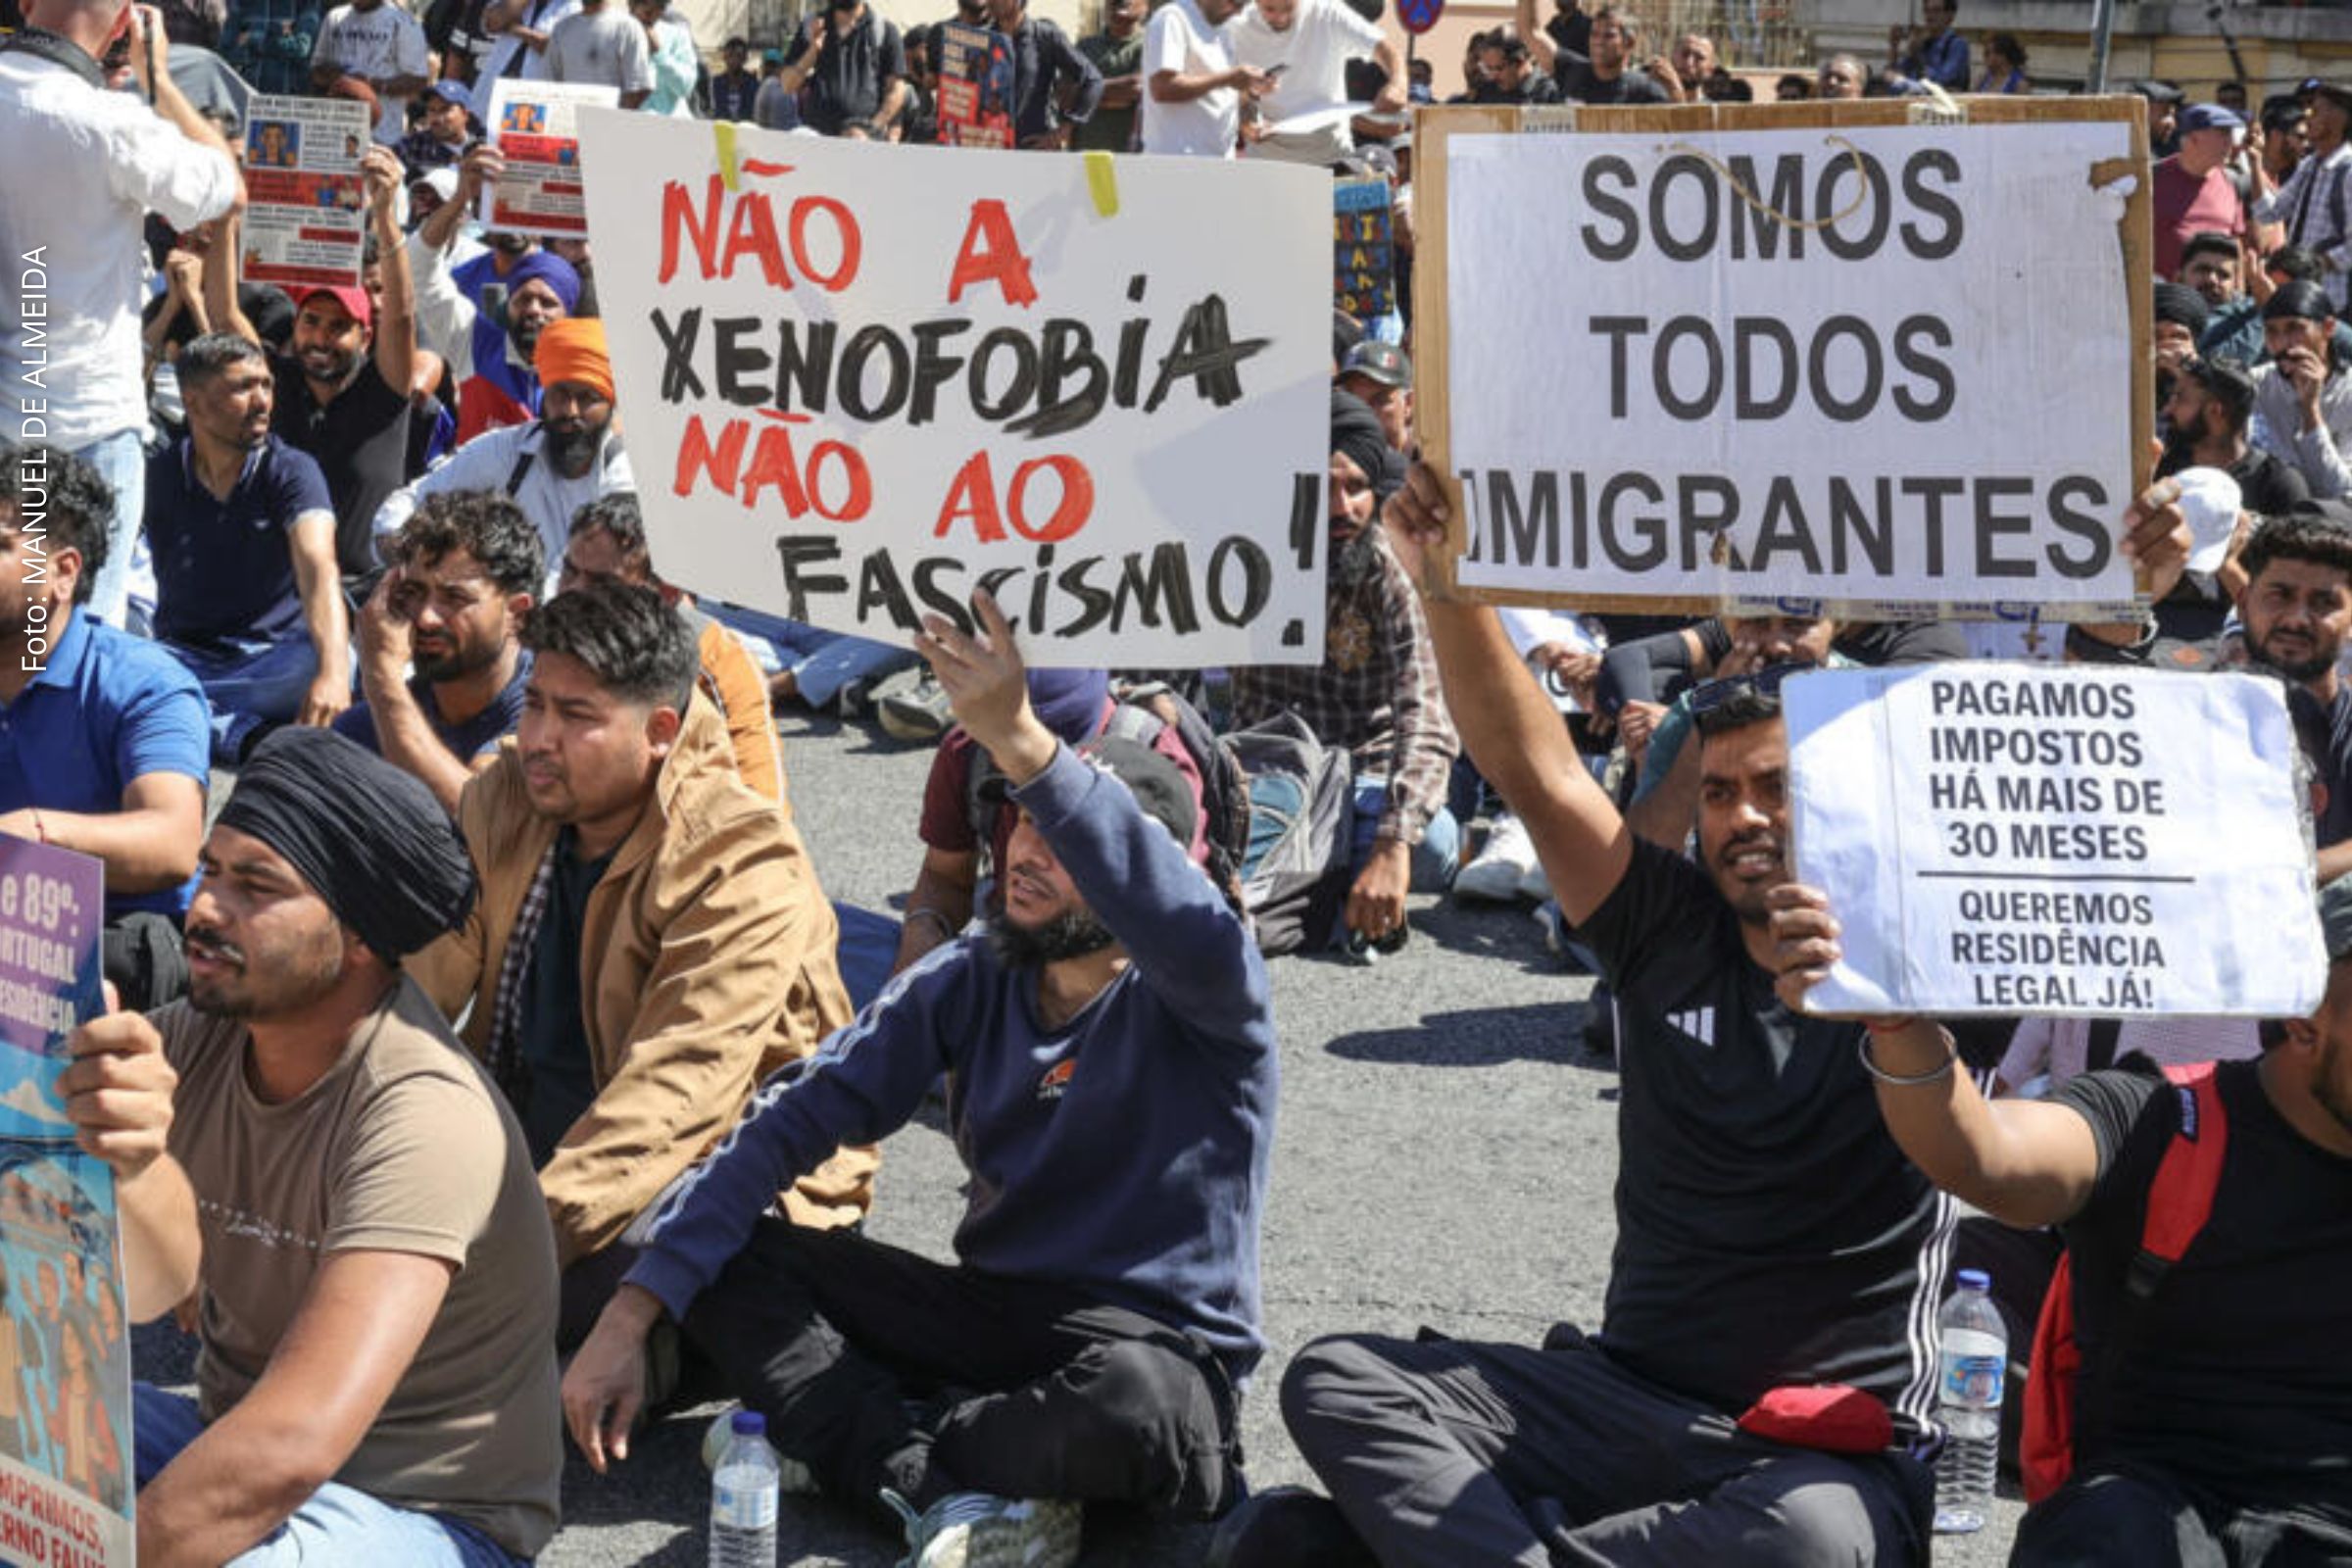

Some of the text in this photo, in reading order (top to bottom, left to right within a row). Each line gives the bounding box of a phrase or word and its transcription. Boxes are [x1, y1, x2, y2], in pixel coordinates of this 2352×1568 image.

[1580, 149, 1964, 262] SOMOS
[658, 159, 1039, 310] NÃO A
[1589, 314, 1957, 422] TODOS
[673, 408, 1095, 544] NÃO AO
[1932, 680, 2135, 719] PAGAMOS
[1931, 727, 2143, 767] IMPOSTOS
[1931, 767, 2165, 815] HÁ MAIS DE
[1948, 822, 2148, 860] 30 MESES
[1959, 890, 2154, 925] QUEREMOS
[1951, 927, 2166, 968] RESIDÊNCIA
[1975, 970, 2154, 1009] LEGAL JÁ!
